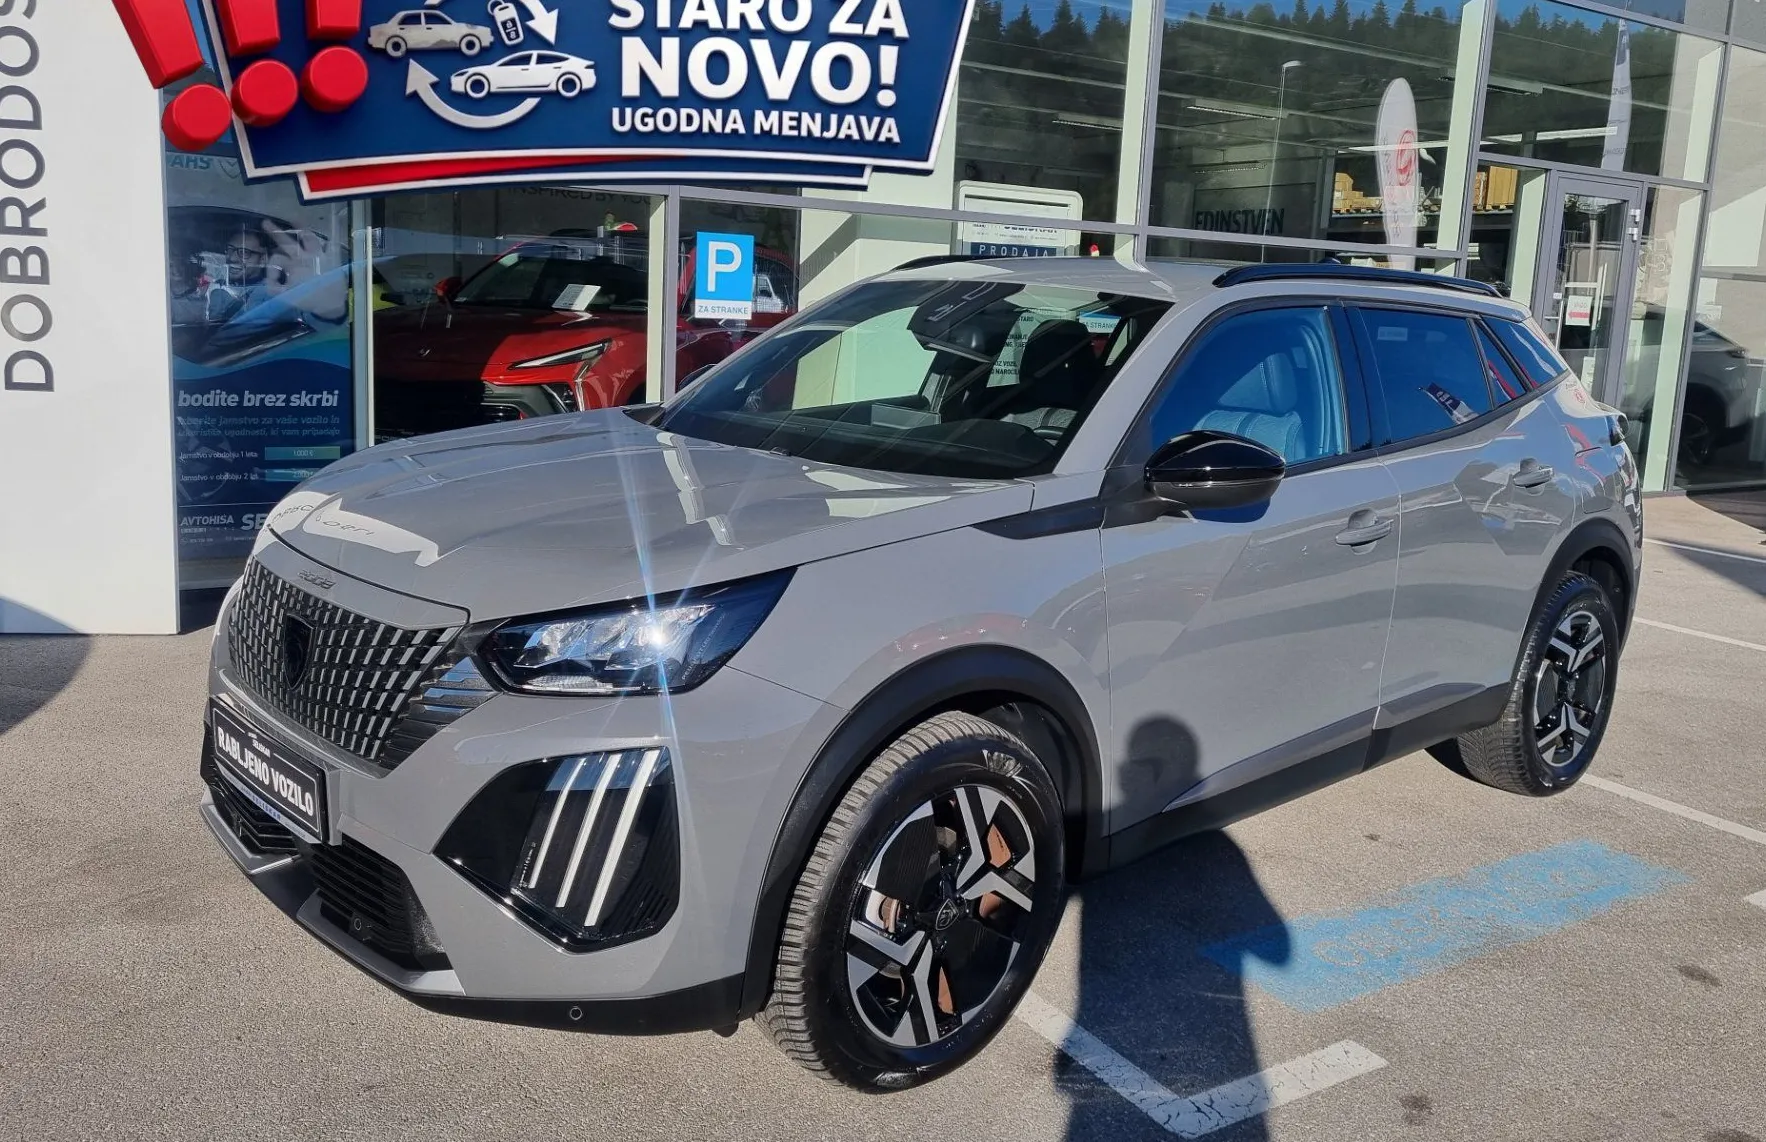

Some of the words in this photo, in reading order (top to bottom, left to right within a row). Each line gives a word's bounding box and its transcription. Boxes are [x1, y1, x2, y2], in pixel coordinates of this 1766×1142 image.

[707, 240, 742, 293] P
[698, 305, 709, 313] ZA
[710, 305, 749, 315] STRANKE
[177, 390, 239, 407] bodite
[243, 390, 286, 407] brez
[289, 390, 339, 407] skrbi
[180, 514, 235, 527] AVTOHIŠA
[217, 726, 270, 786] RABLJENO
[270, 768, 314, 817] VOZILO
